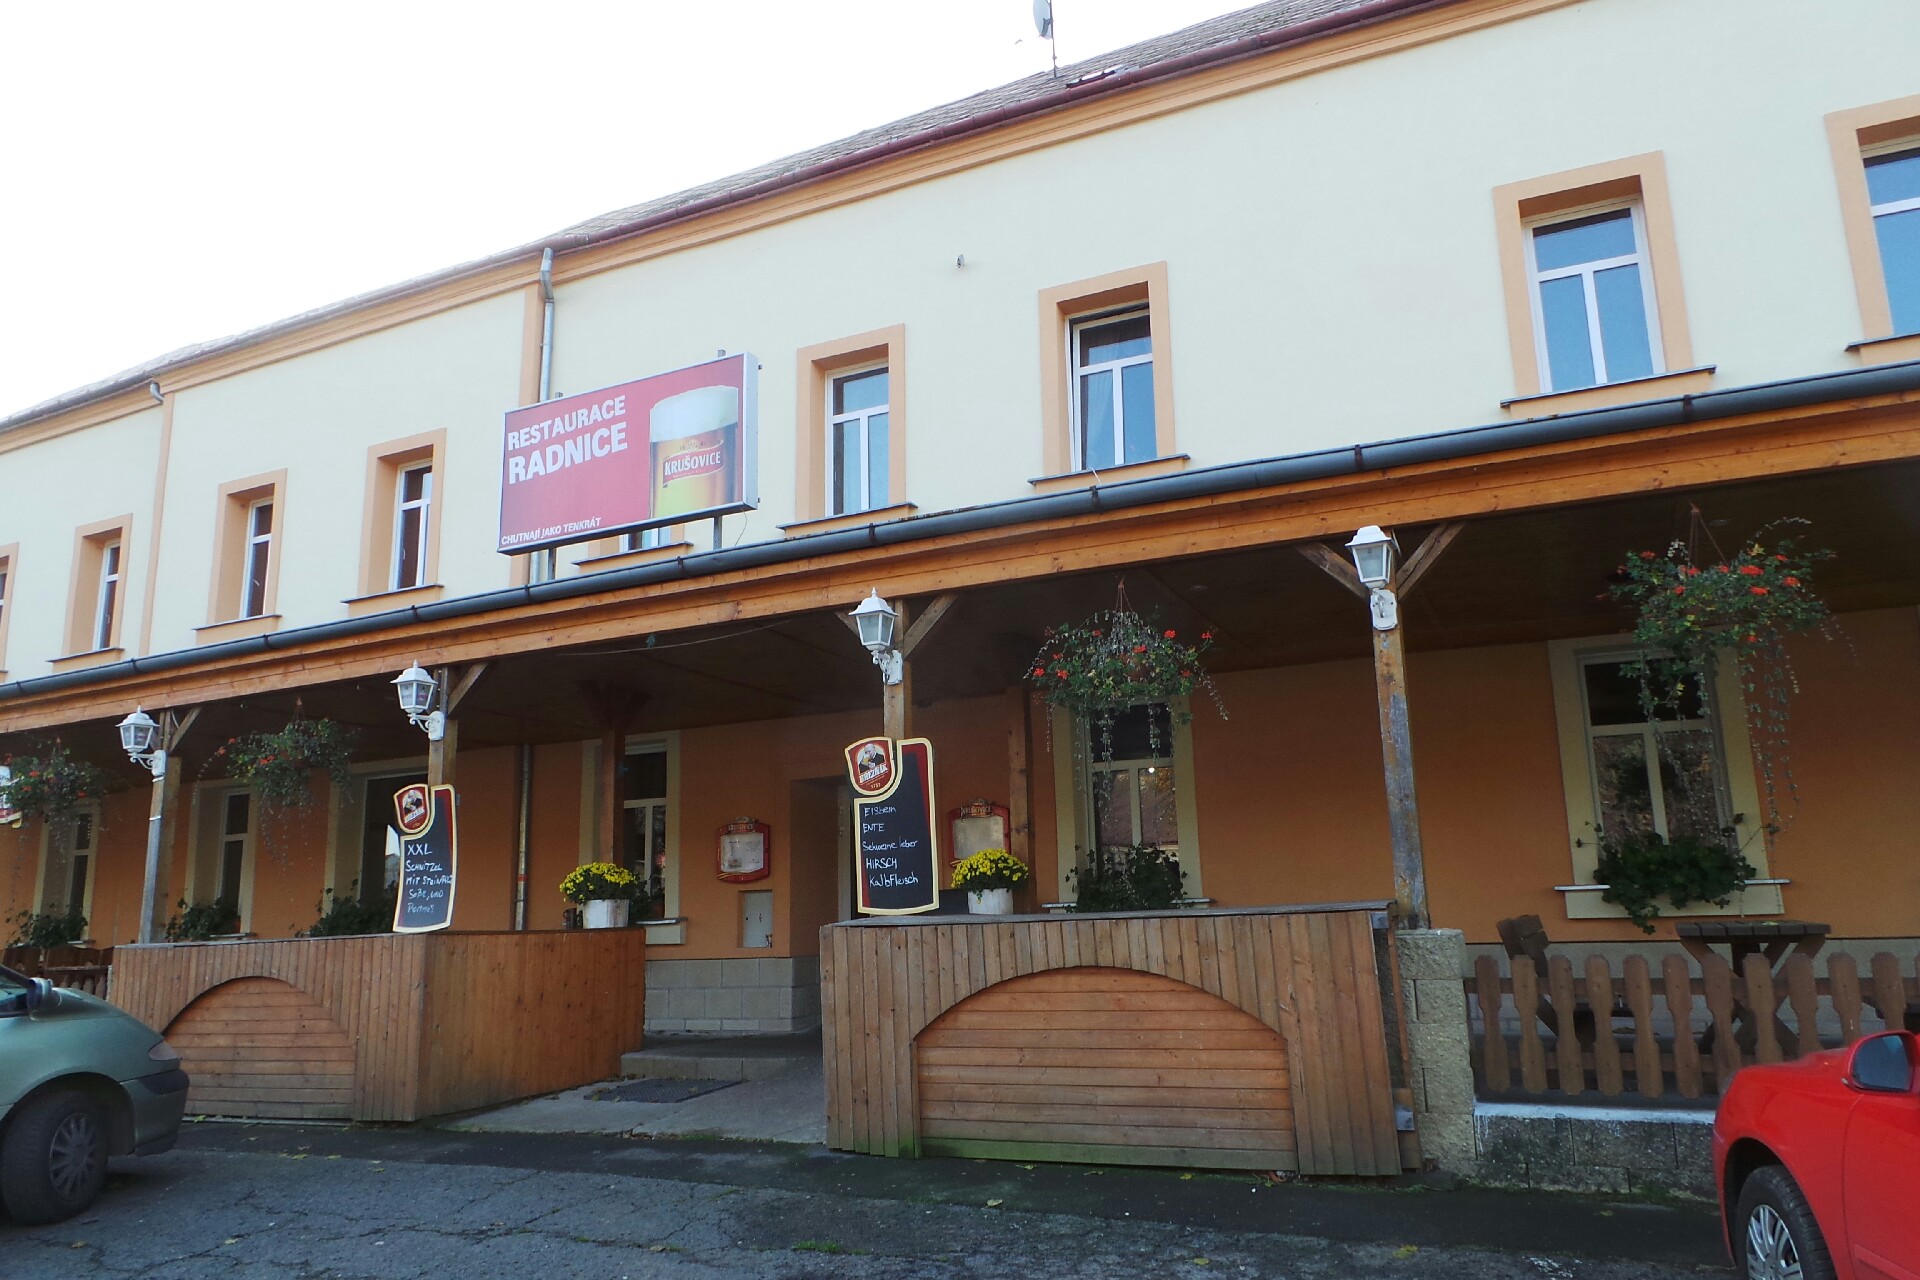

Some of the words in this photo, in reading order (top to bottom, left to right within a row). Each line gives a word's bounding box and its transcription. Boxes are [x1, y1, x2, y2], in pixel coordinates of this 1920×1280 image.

[507, 395, 627, 451] RESTAURACE
[508, 422, 628, 485] RADNICE
[664, 451, 721, 476] KRUŠOVICE
[501, 527, 541, 546] CHUTNAJÍ
[541, 524, 562, 539] JAKO
[563, 516, 602, 535] TENKRÁT
[862, 823, 885, 834] ENTE
[407, 843, 433, 856] XXL
[865, 857, 898, 870] HIRSCH
